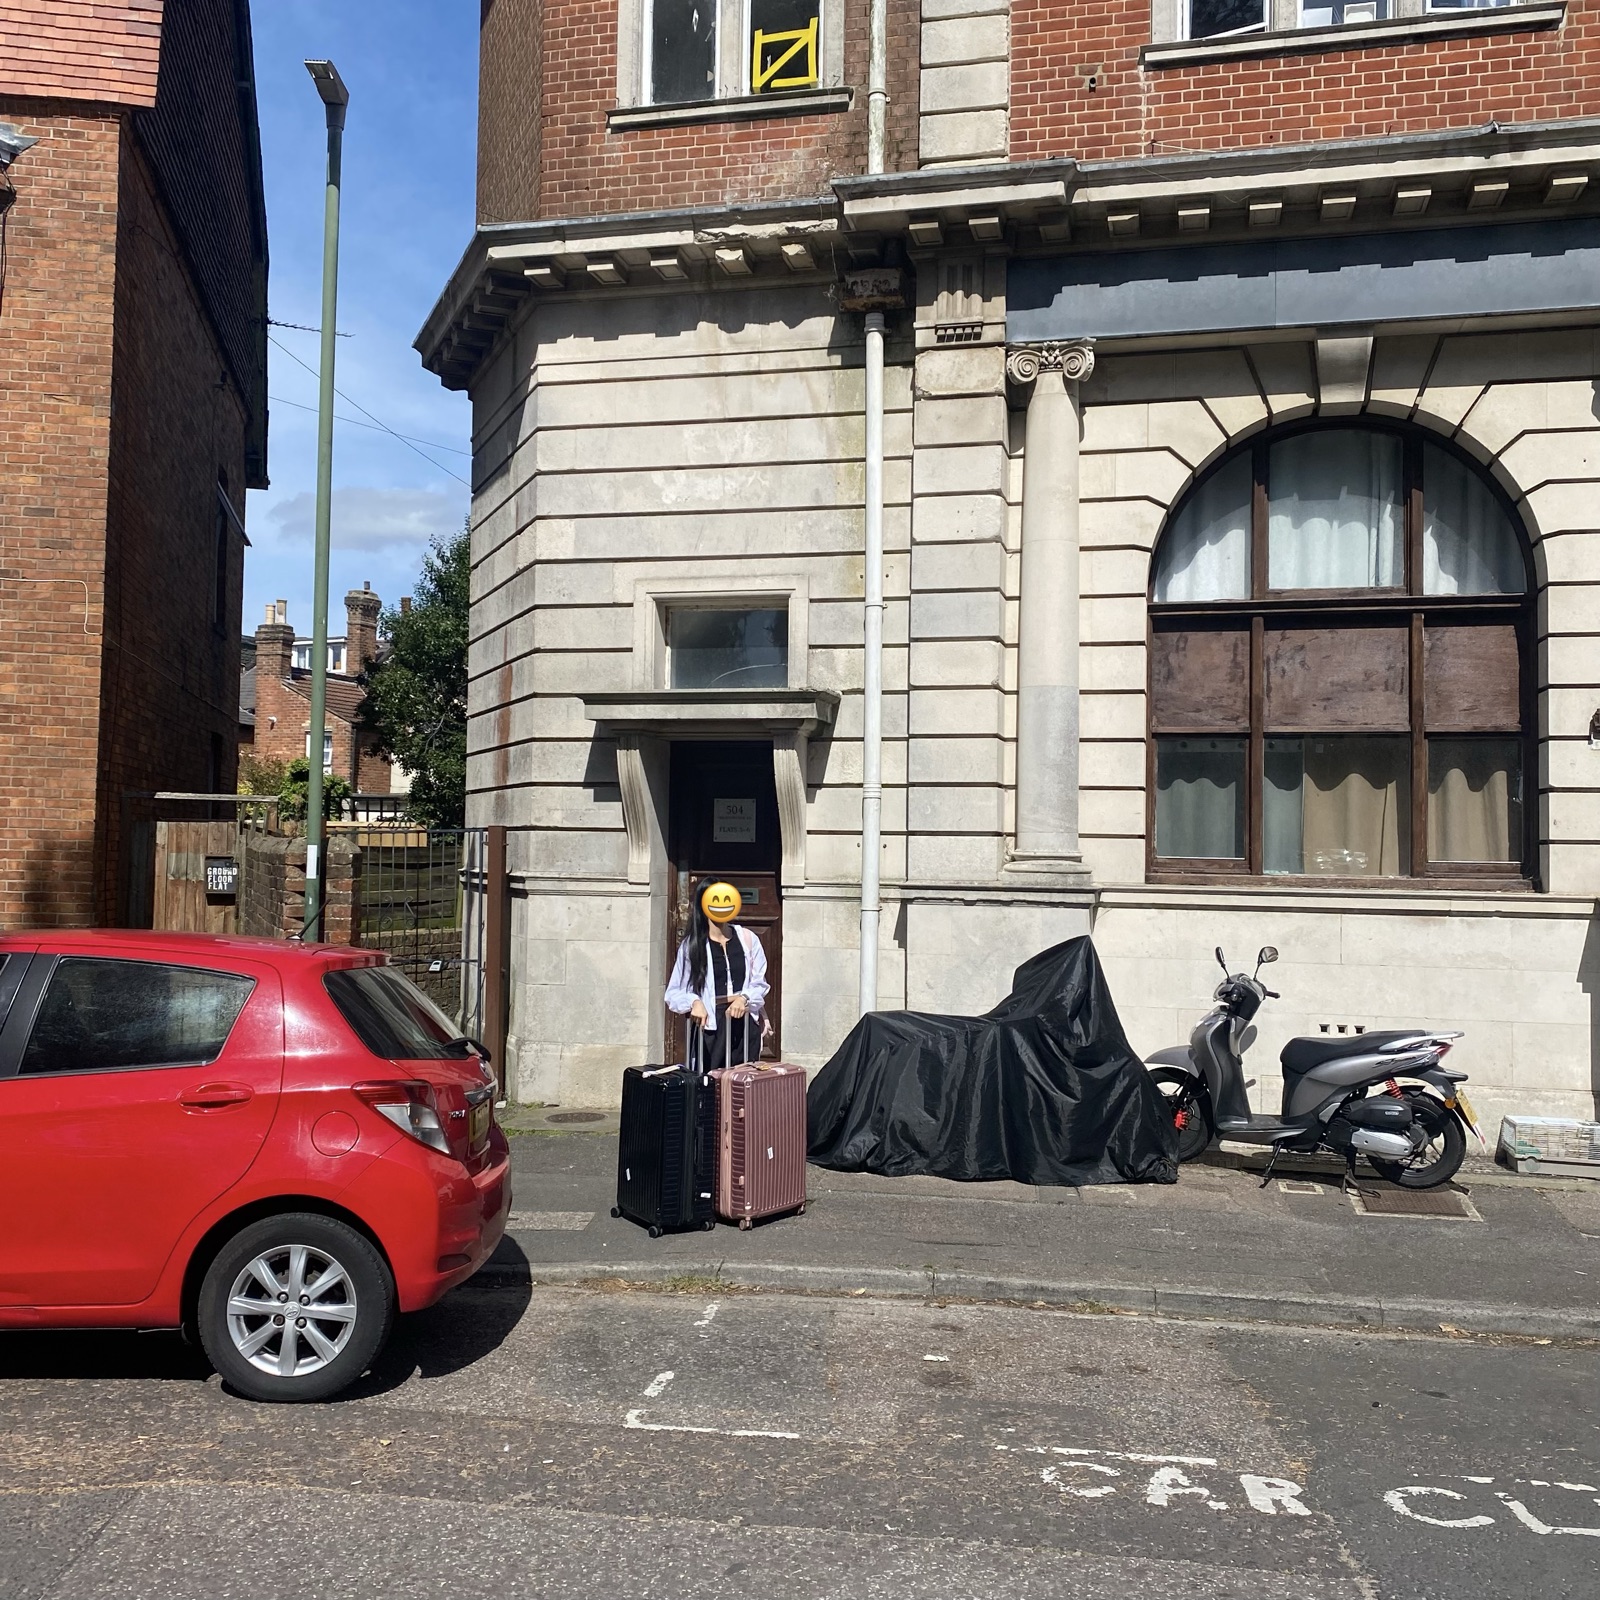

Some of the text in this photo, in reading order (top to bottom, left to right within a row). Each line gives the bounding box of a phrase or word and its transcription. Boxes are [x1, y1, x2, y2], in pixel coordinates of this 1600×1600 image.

[726, 805, 744, 814] 504
[207, 875, 233, 883] FLOOR
[207, 882, 228, 890] FLAT
[1041, 1460, 1600, 1537] CAR CL
